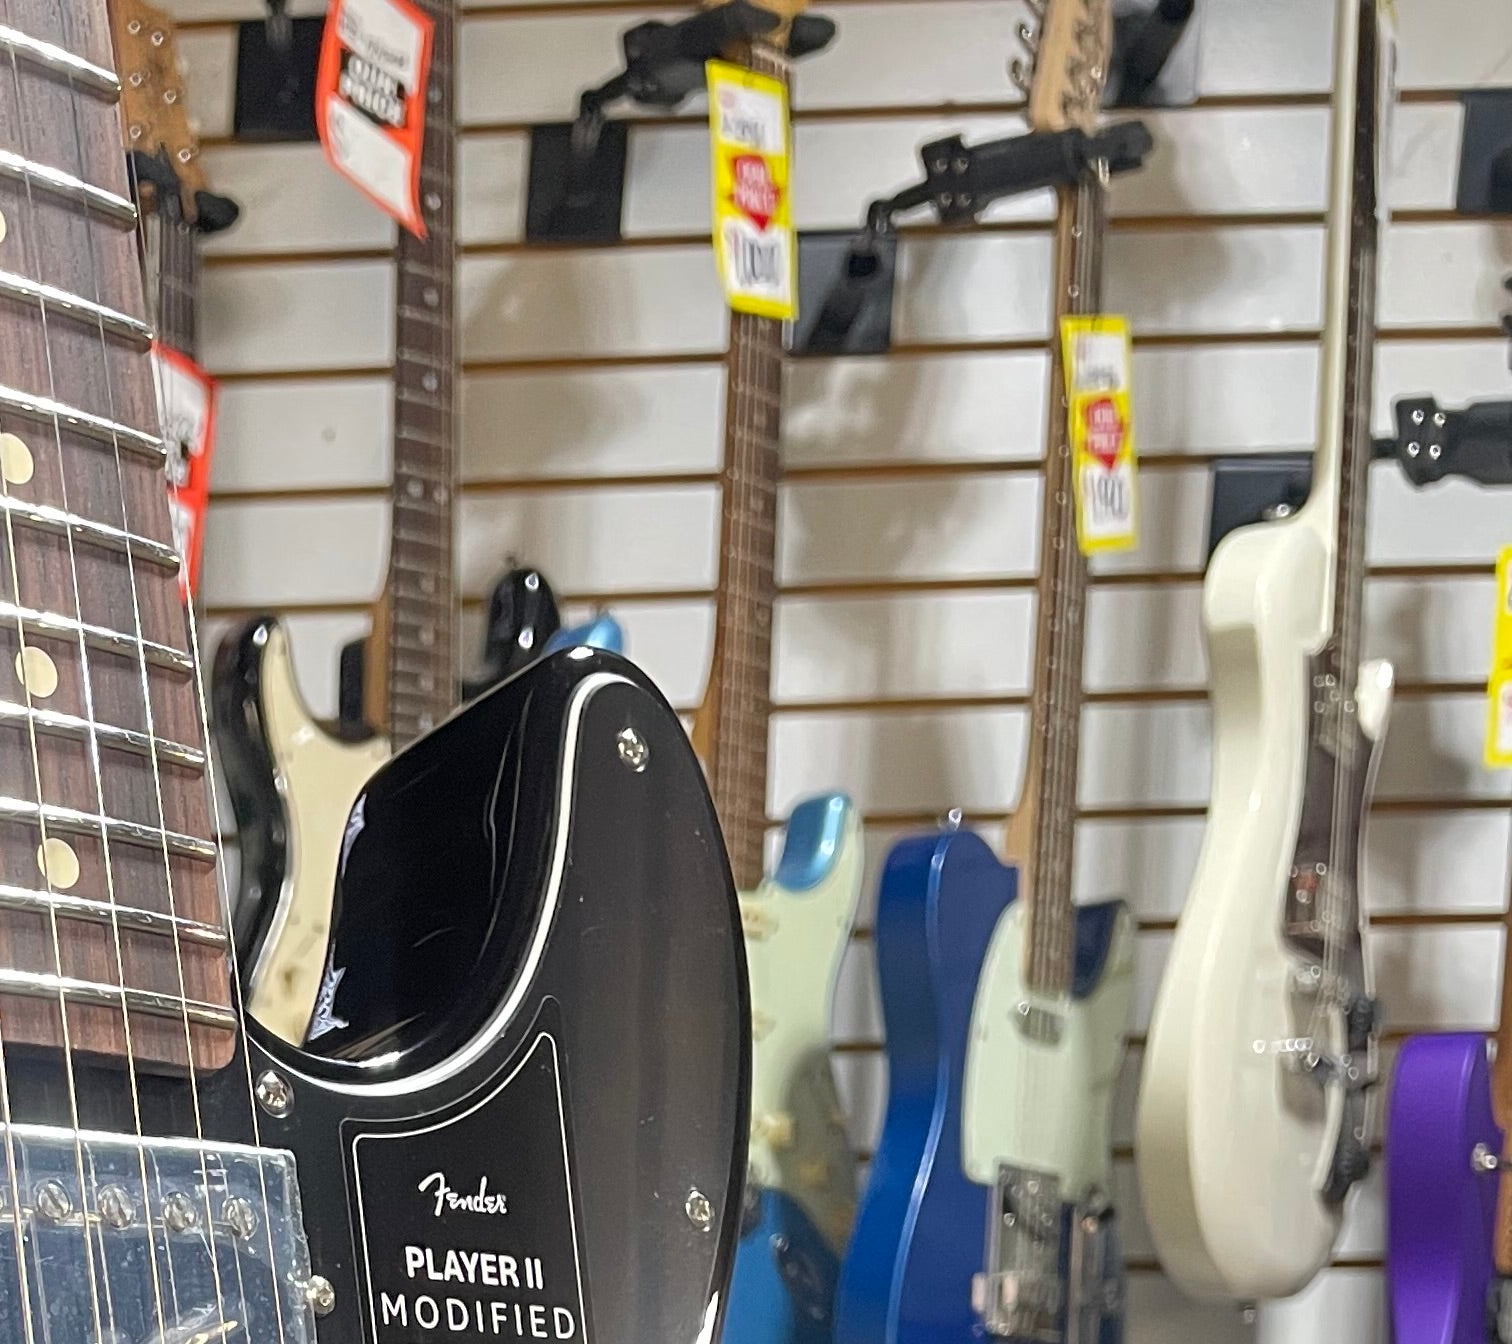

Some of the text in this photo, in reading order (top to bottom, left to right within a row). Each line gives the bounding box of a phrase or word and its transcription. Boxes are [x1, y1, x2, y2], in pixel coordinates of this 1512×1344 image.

[417, 1171, 508, 1217] Fender
[404, 1245, 544, 1290] PLAYER II
[380, 1292, 576, 1340] MODIFIED
